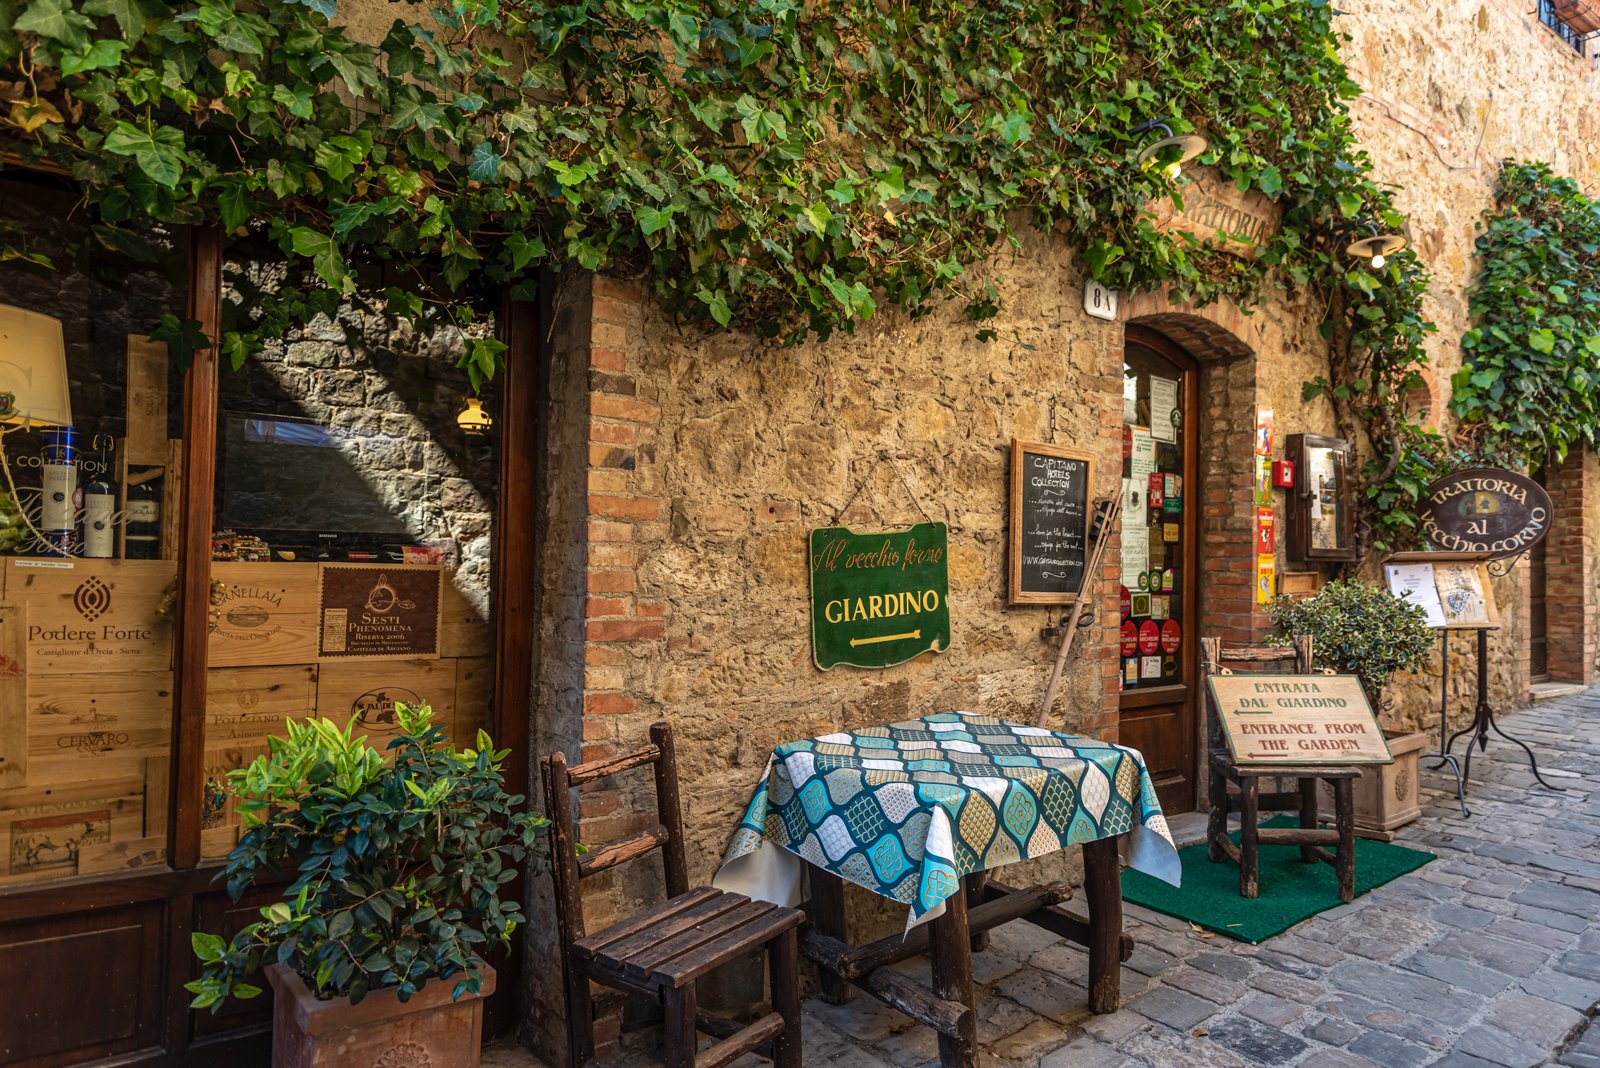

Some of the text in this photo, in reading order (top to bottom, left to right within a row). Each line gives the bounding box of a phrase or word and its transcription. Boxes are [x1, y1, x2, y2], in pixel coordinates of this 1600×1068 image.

[1046, 469, 1071, 480] HOTELS
[1031, 477, 1070, 489] COLLECTION
[1430, 478, 1528, 505] TRATTORIA
[845, 538, 900, 569] vecchio
[902, 538, 943, 572] forno
[825, 589, 939, 624] GIARDINO
[361, 612, 401, 625] SESTI
[29, 624, 152, 641] Podere Forte
[348, 623, 412, 632] PHENOMENA
[36, 649, 82, 657] Castiglione
[1253, 683, 1321, 693] ENTRATA
[1239, 698, 1347, 708] DAL GIARDINO
[214, 714, 280, 725] POLIZIANO
[1240, 723, 1366, 735] ENTRANCE FROM
[57, 732, 129, 748] CERVARO
[1258, 739, 1361, 750] THE GARDEN
